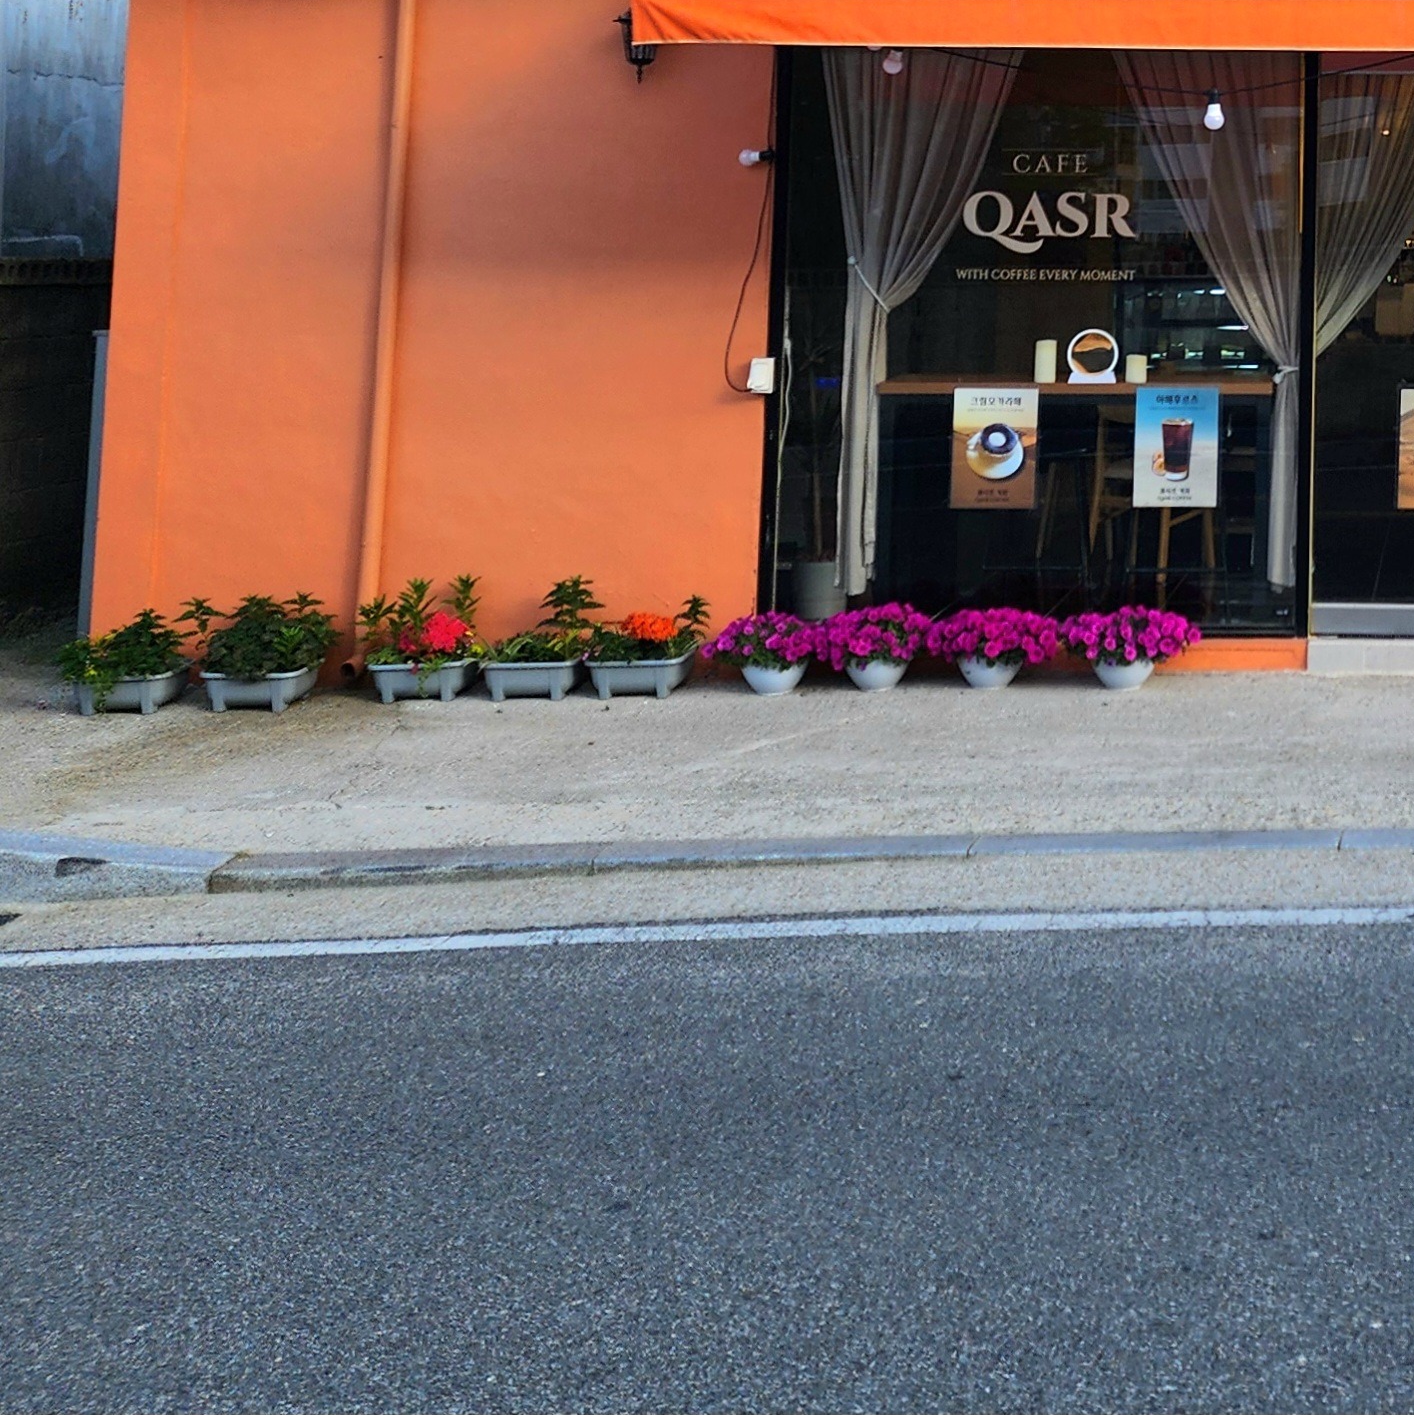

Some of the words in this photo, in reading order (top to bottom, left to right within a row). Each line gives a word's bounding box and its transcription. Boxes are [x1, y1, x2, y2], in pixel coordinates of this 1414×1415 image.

[1012, 153, 1089, 174] CAFE
[963, 190, 1137, 254] QASR
[955, 268, 989, 280] WITH
[991, 268, 1037, 281] COFFEE
[1039, 269, 1078, 281] EVERY
[1079, 269, 1137, 282] MOMENT
